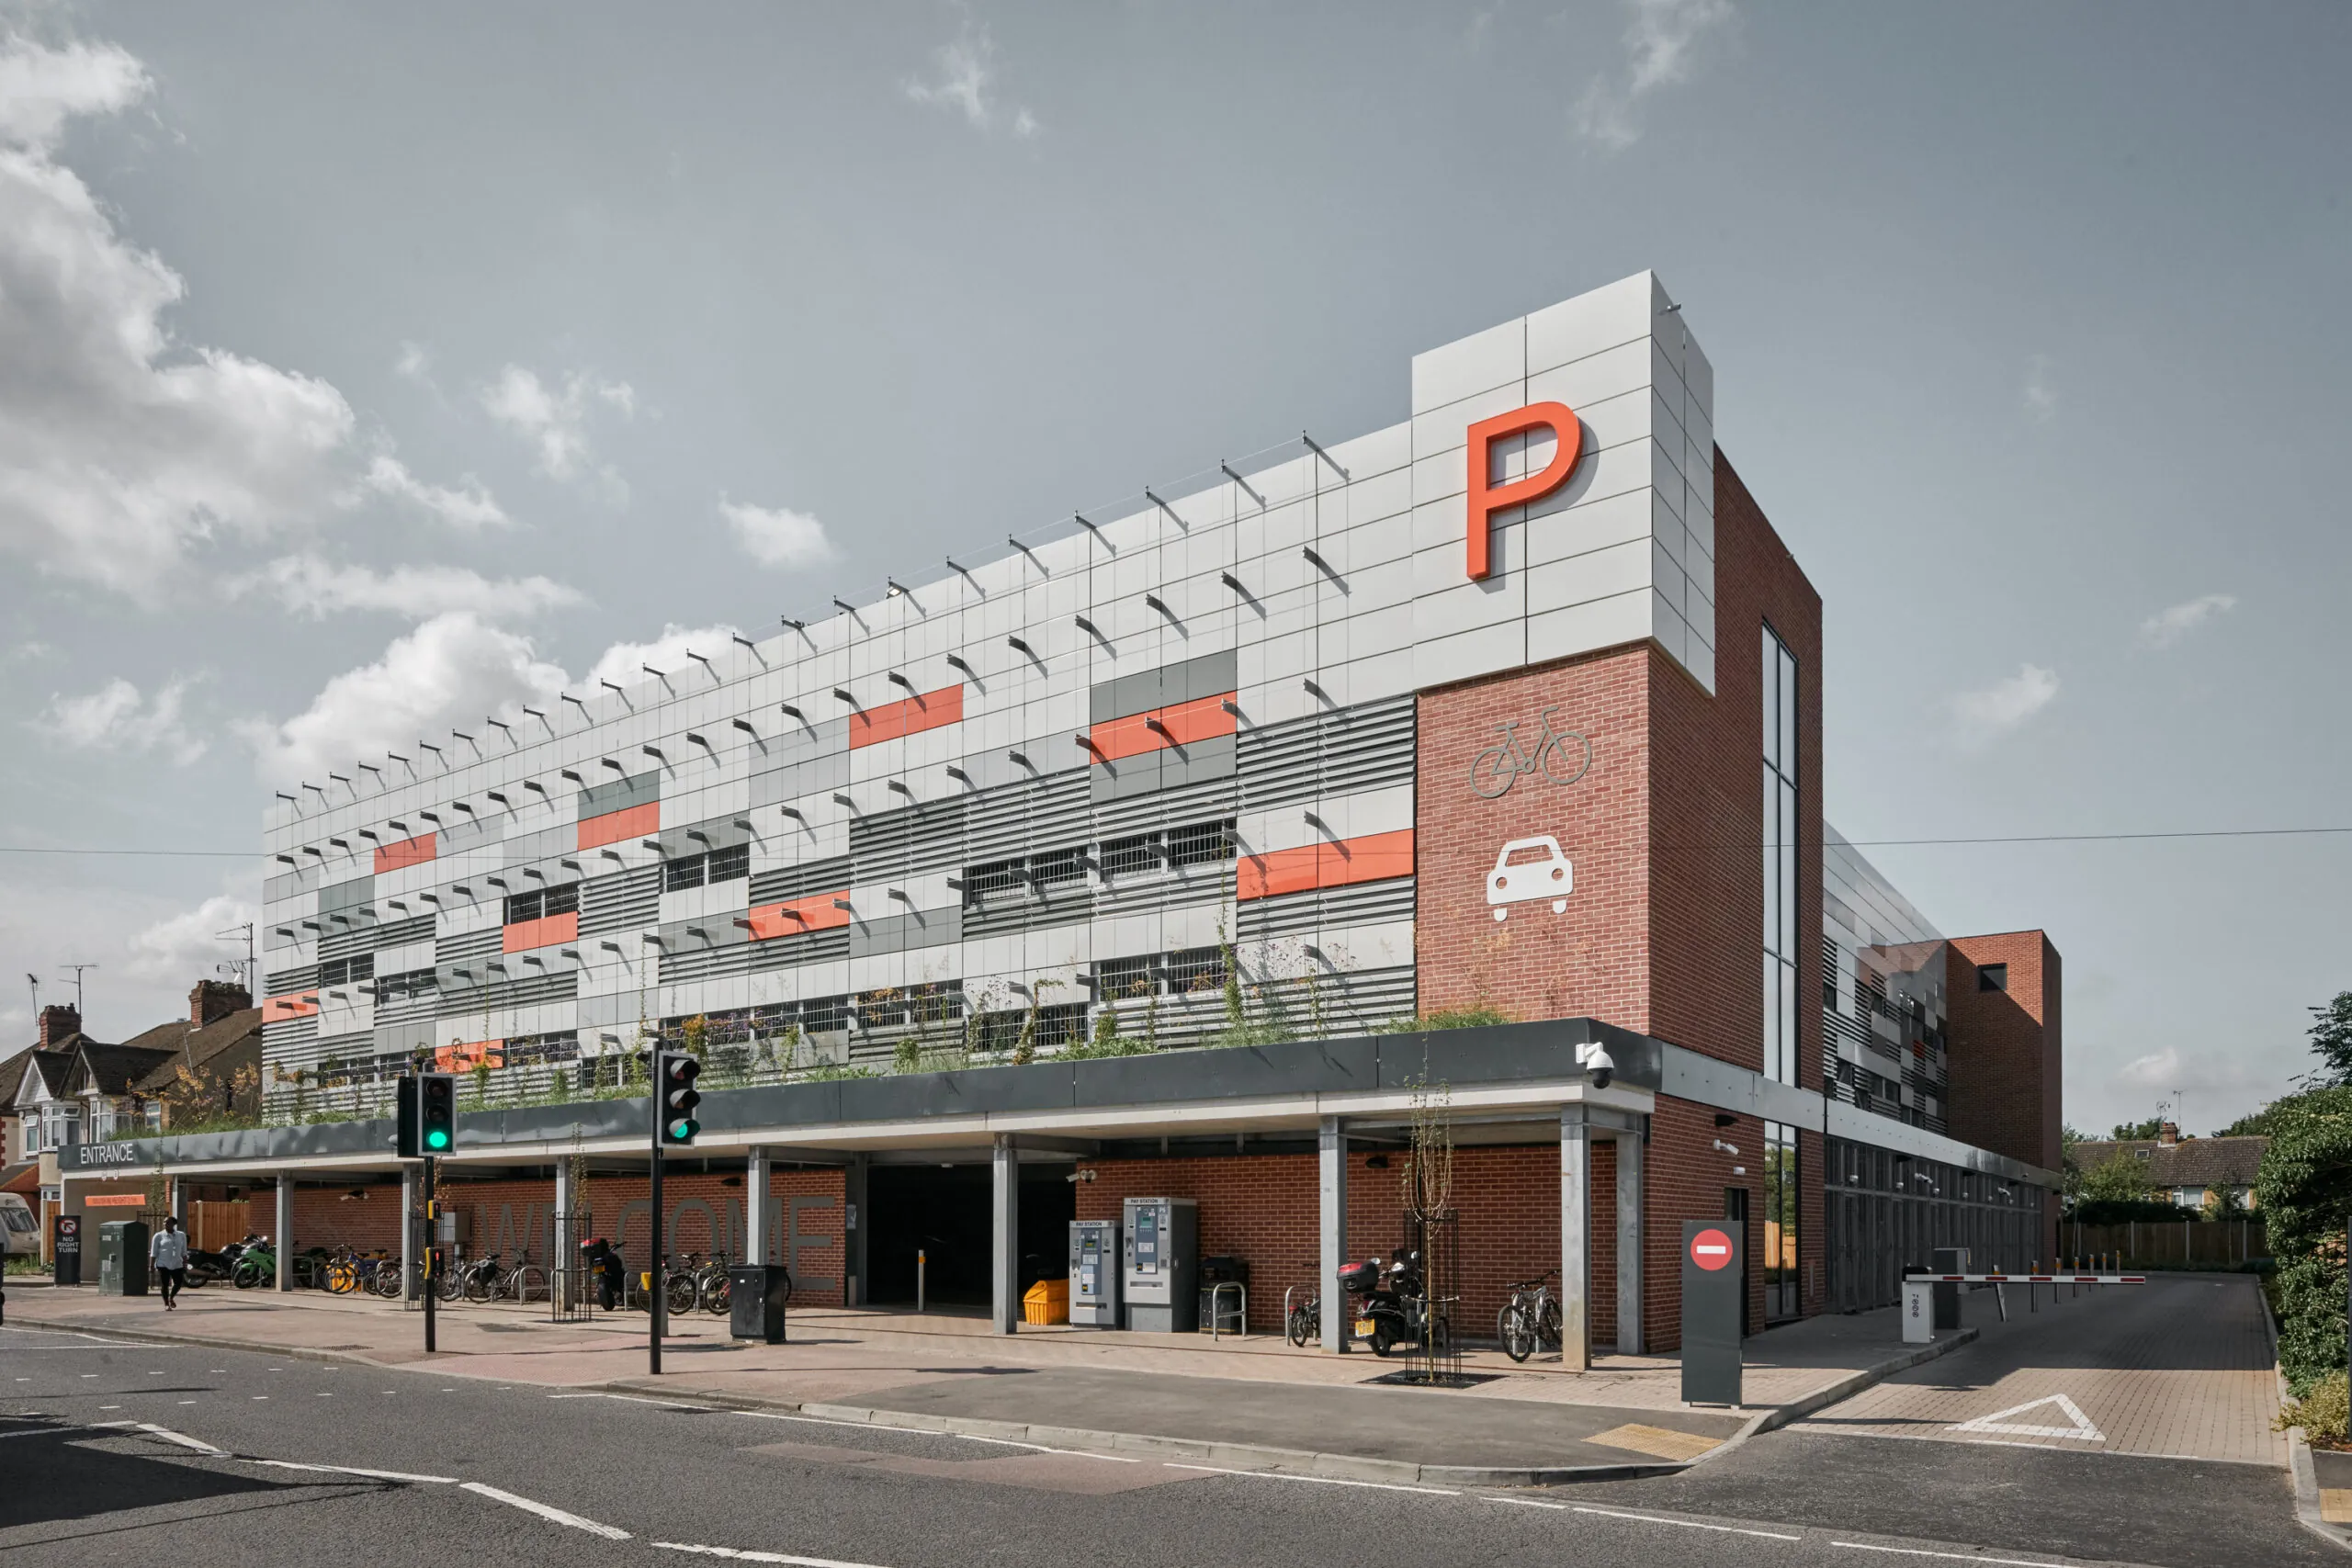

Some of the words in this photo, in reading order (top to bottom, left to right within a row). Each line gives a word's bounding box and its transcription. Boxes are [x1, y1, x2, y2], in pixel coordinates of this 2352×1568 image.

[1467, 400, 1584, 581] P
[80, 1144, 133, 1165] ENTRANCE
[480, 1196, 837, 1291] WCOME
